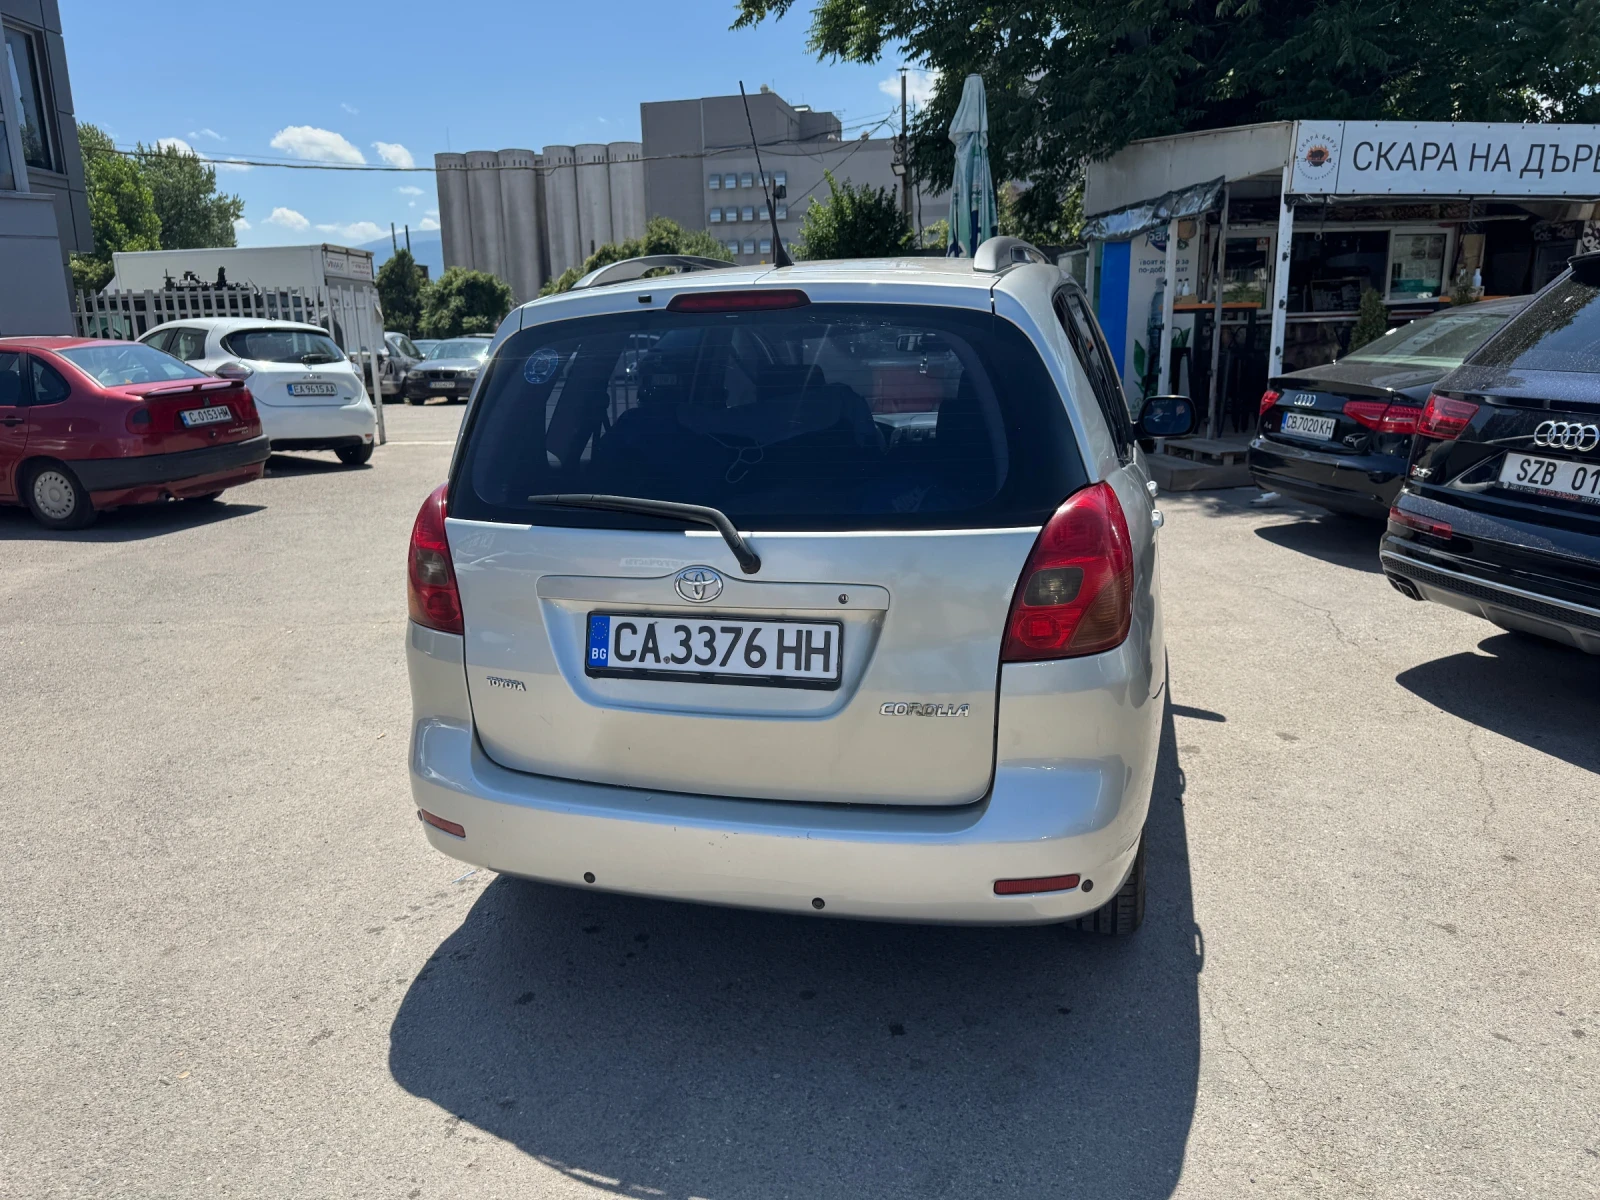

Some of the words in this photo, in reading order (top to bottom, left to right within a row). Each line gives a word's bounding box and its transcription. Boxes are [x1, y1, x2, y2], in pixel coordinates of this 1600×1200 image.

[1352, 141, 1458, 171] СКАРА
[1468, 143, 1511, 172] НА
[1516, 458, 1557, 486] SZB
[1571, 467, 1600, 495] 01
[592, 648, 607, 660] BG
[671, 625, 767, 668] 3376
[776, 629, 831, 672] HH
[486, 676, 526, 691] TOYOTA
[880, 702, 970, 717] COROLLA
